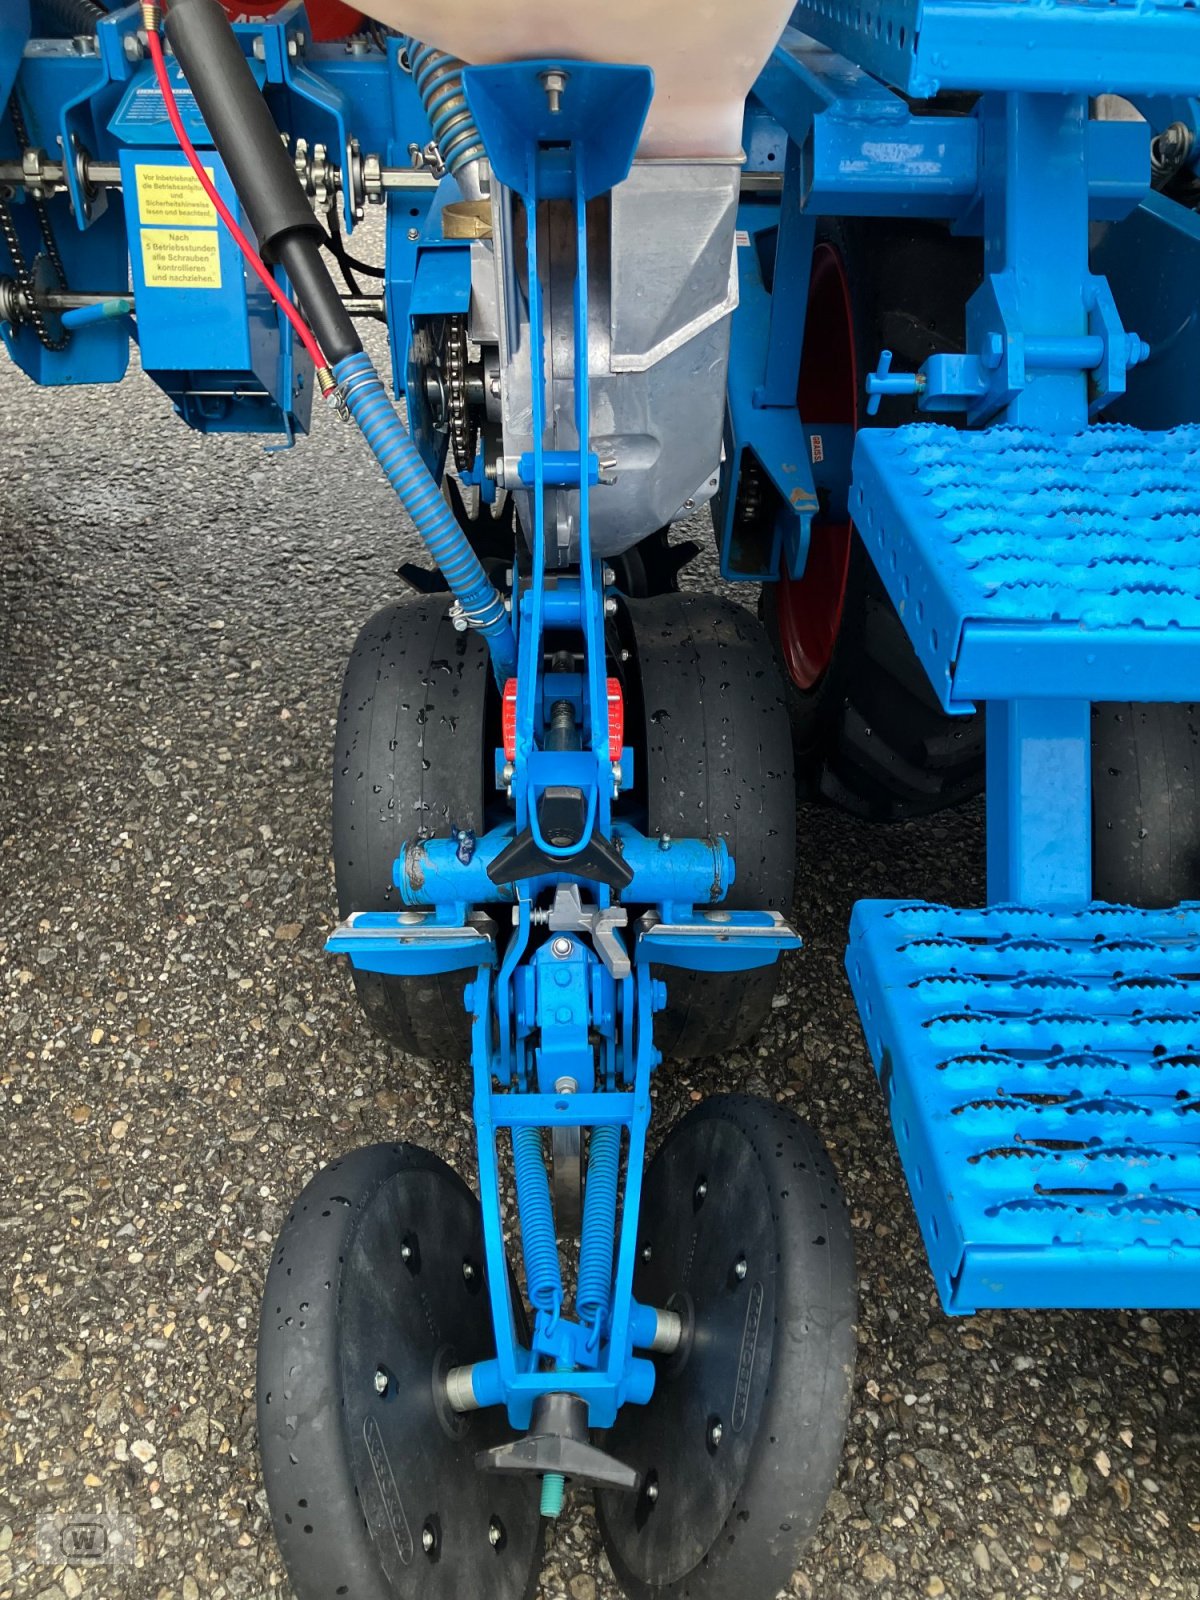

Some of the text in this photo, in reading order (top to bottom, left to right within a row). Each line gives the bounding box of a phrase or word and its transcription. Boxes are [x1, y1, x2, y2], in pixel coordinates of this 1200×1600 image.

[157, 174, 198, 182] Inbetriebnah
[146, 200, 209, 208] Sicherheitshinweise
[169, 233, 189, 241] Nach
[152, 243, 216, 252] Betriebsstunden
[152, 253, 209, 262] alle Schrauben
[157, 264, 206, 272] kontrollieren
[169, 274, 216, 283] nachziehen.
